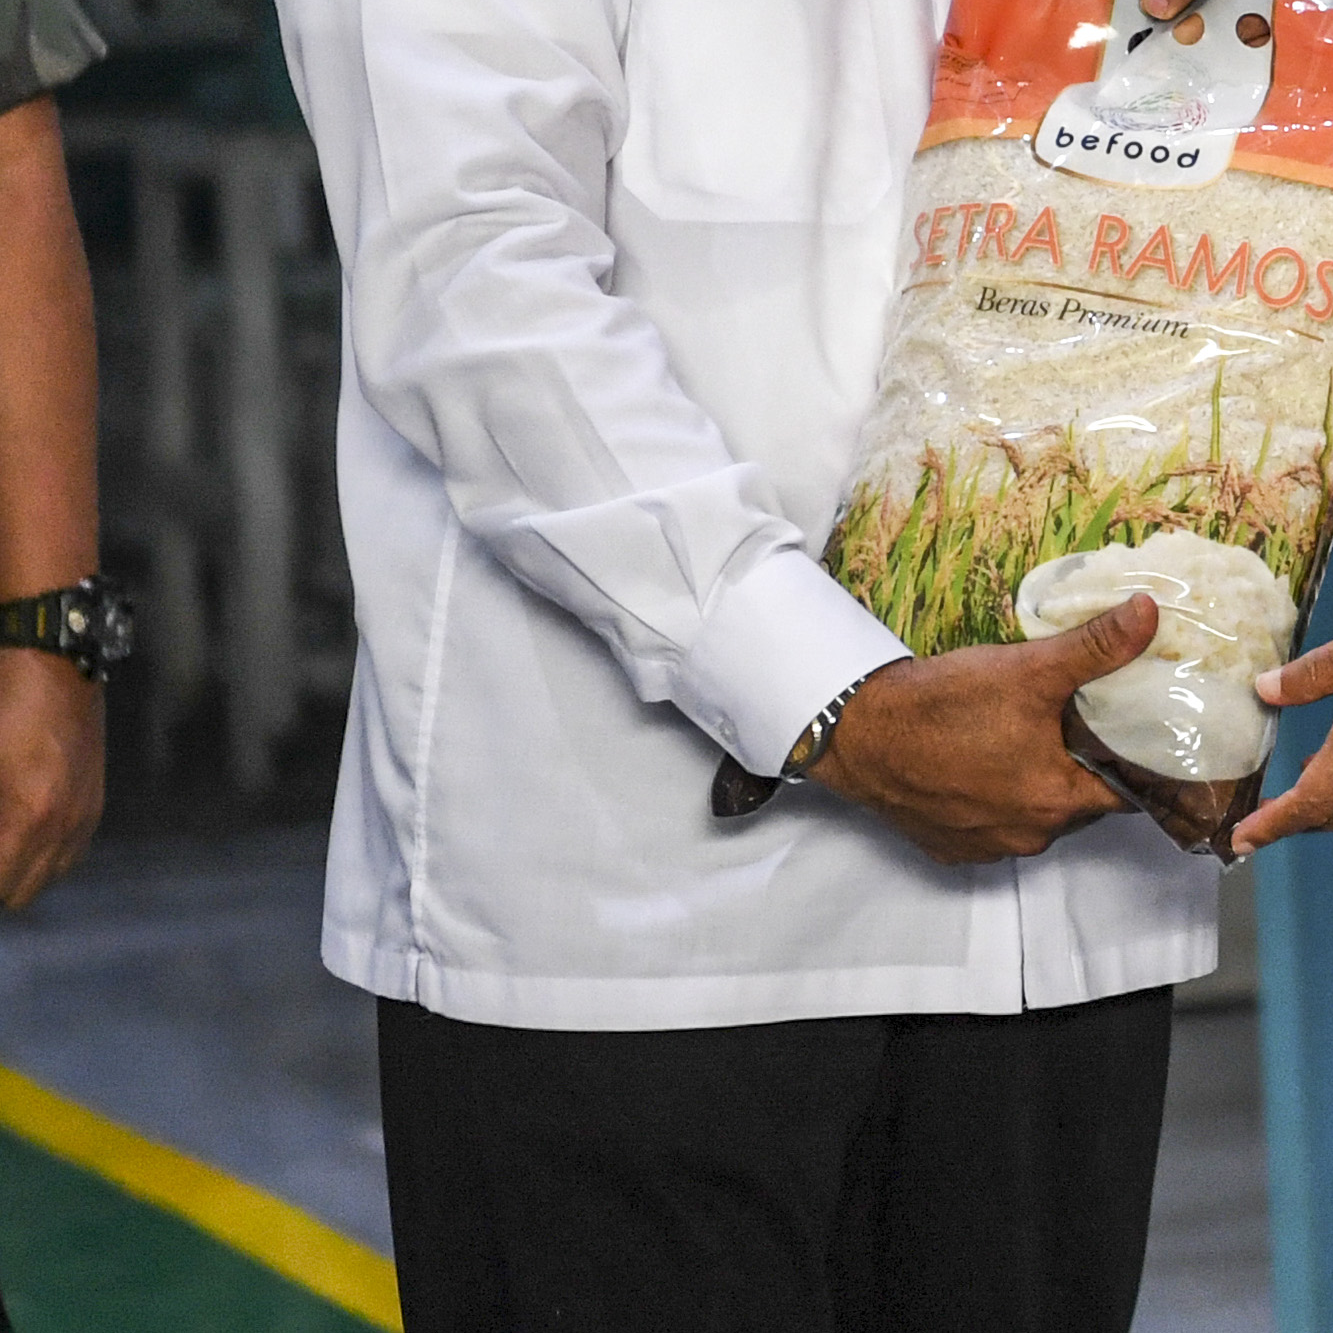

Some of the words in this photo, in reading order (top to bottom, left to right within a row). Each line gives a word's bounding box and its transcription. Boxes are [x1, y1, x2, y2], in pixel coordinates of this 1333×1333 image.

[1055, 126, 1201, 169] befood
[913, 201, 1063, 267] SETRA
[976, 286, 1051, 316] Beras
[1057, 297, 1191, 340] Premium
